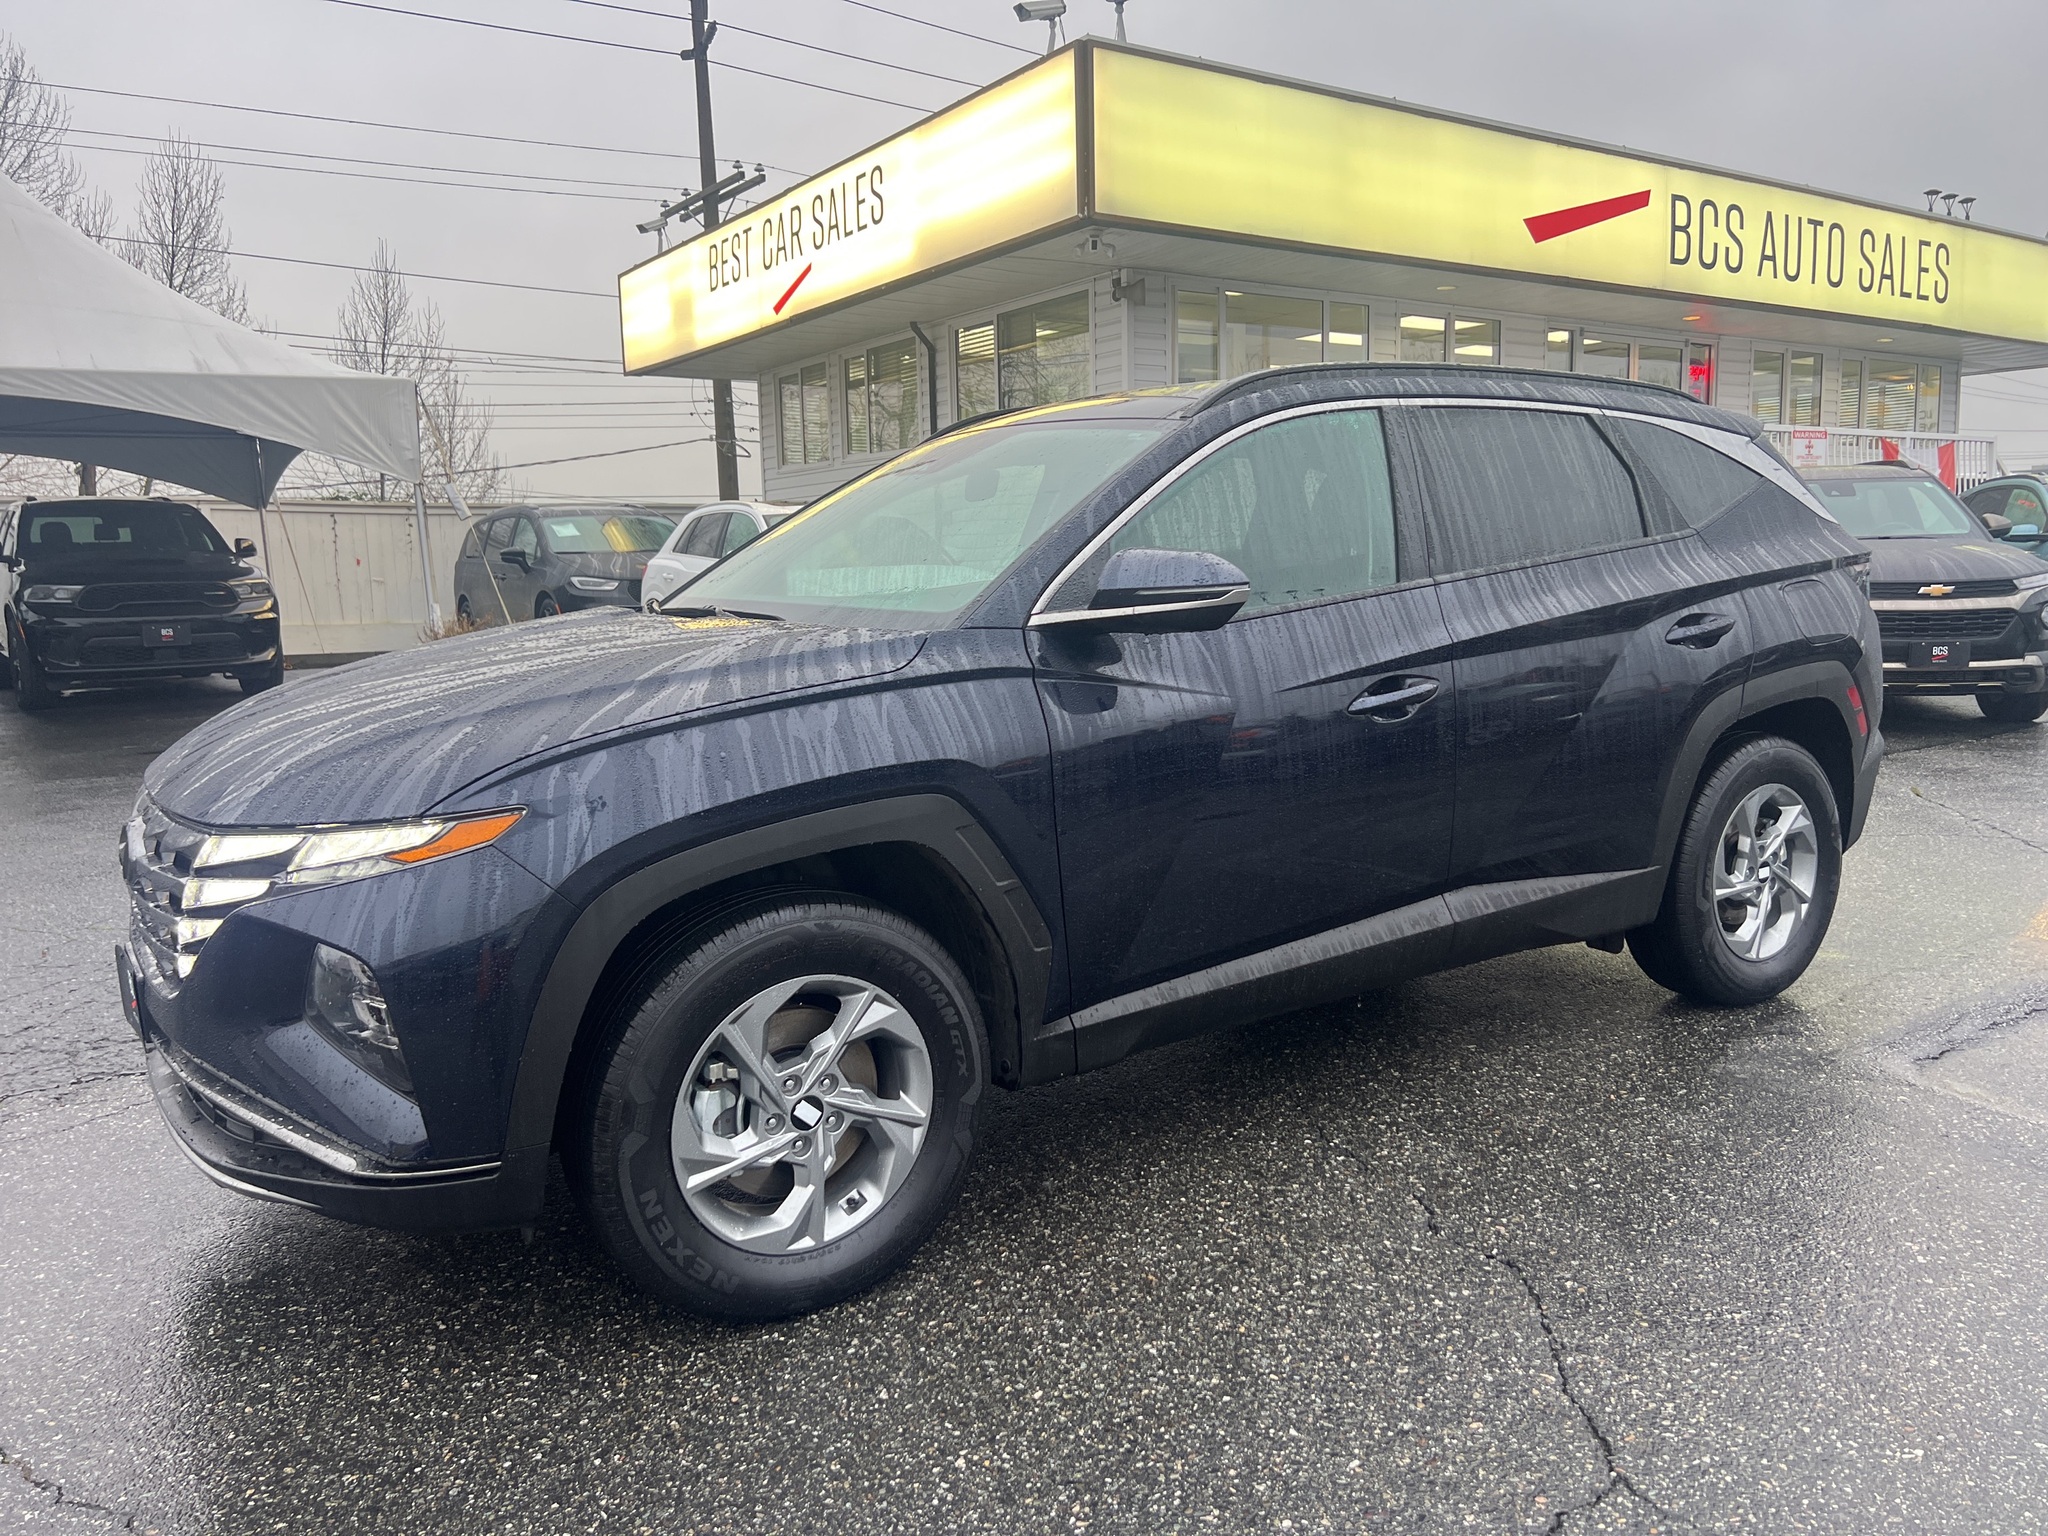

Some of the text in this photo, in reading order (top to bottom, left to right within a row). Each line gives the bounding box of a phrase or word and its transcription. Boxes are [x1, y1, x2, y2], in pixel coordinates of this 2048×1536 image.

[709, 165, 884, 292] BEST CAR SALES
[1669, 193, 1950, 304] BCS AUTO SALES
[1793, 431, 1826, 439] WARNING
[161, 628, 173, 636] BCS
[1932, 646, 1948, 655] BCS
[639, 1186, 741, 1294] NEXEN
